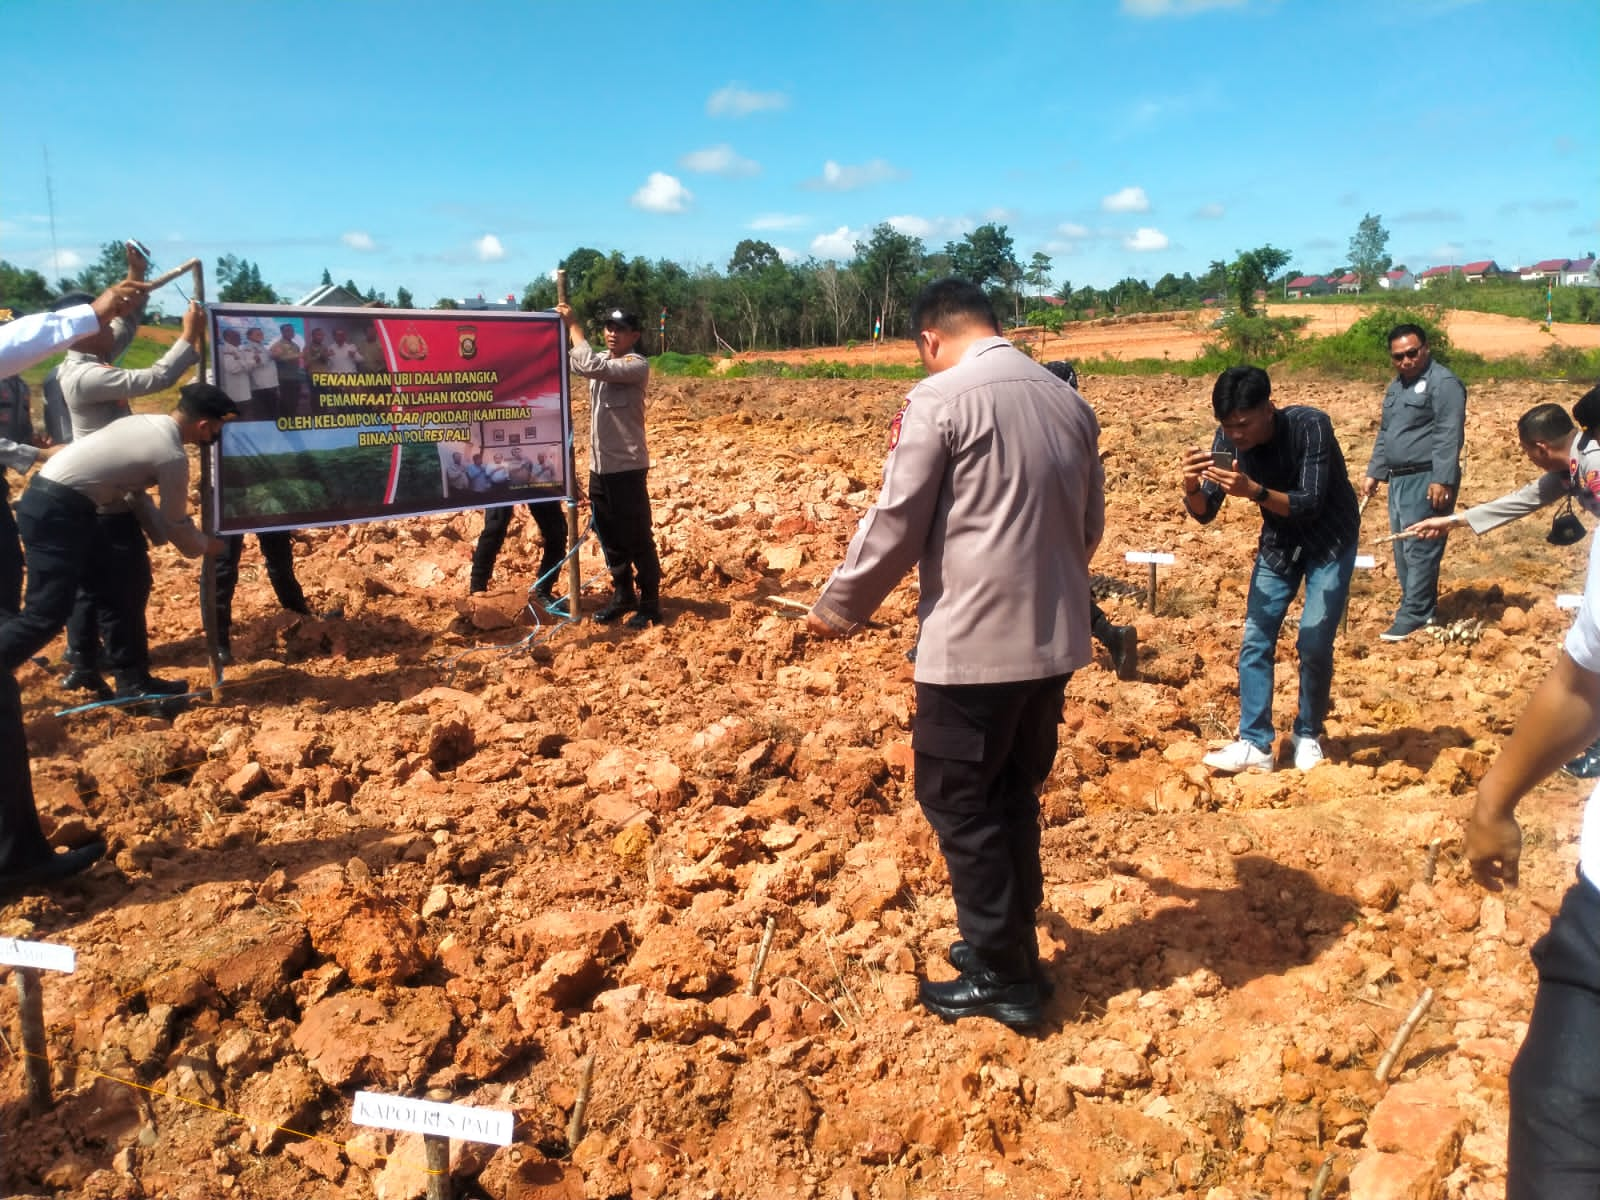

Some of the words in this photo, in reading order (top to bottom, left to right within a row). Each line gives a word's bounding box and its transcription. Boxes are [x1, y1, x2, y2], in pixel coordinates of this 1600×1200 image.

[313, 373, 391, 386] PENANAMAN
[394, 373, 412, 385] UBI
[415, 372, 452, 384] DALAM
[455, 371, 498, 383] RANGKA
[320, 392, 409, 407] PEMANFAATAN
[411, 391, 448, 405] LAHAN
[450, 390, 494, 403] KOSONG
[277, 415, 312, 430] OLEH
[314, 412, 379, 428] KELOMPOK
[380, 412, 420, 424] SADAR
[473, 407, 532, 421] KAMTIBMAS
[359, 432, 402, 446] BINAAN
[404, 429, 443, 443] POLRES
[445, 428, 471, 441] PALI
